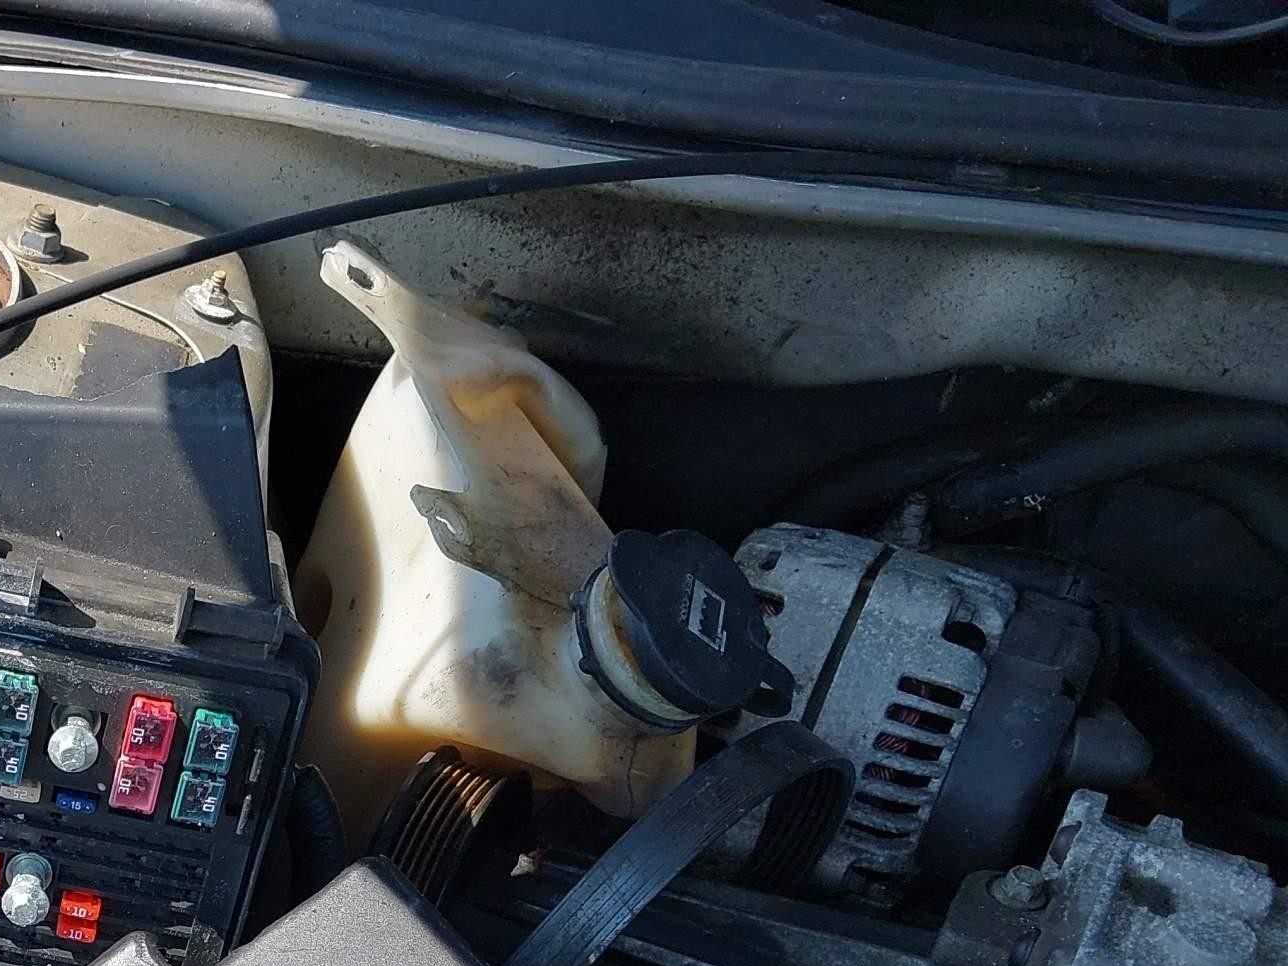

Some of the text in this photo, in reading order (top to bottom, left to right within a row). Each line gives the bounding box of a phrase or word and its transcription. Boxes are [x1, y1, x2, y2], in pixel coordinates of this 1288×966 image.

[15, 703, 30, 721] 40
[132, 727, 144, 745] 50
[216, 742, 230, 760] 40
[4, 756, 19, 774] 40
[118, 777, 131, 795] 30
[70, 800, 81, 811] 15
[202, 795, 216, 812] 40
[71, 906, 87, 918] 10
[67, 928, 83, 940] 10
